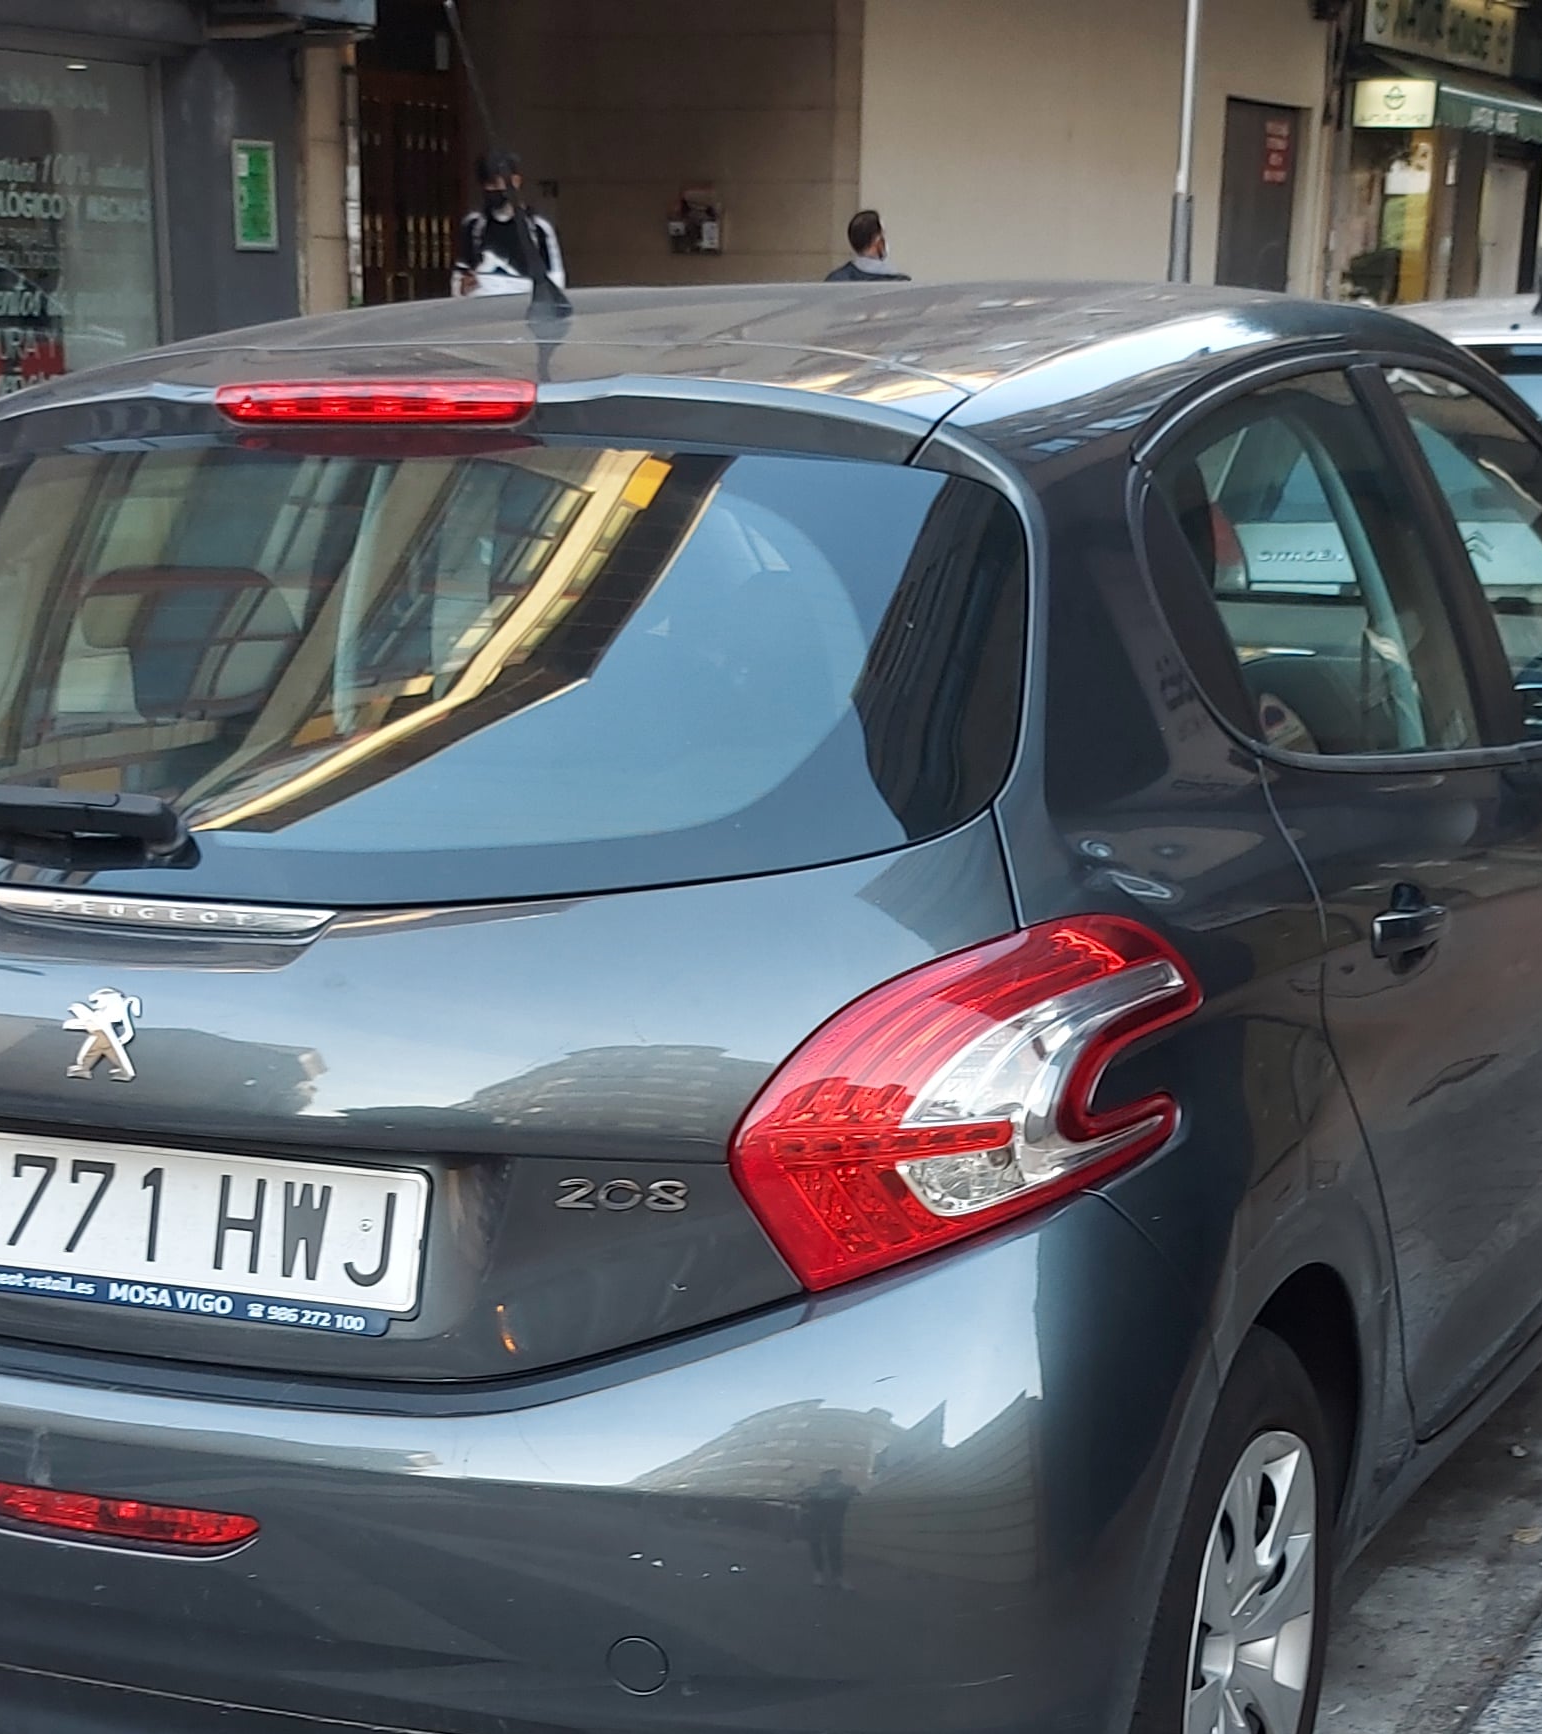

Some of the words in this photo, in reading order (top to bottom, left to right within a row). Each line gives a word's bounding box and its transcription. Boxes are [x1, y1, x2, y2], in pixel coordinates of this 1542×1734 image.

[53, 899, 255, 926] PEUGEOT
[554, 1177, 689, 1213] 208
[213, 1174, 397, 1287] HWJ
[109, 1282, 172, 1308] MOSA
[175, 1290, 234, 1315] VIGO
[267, 1305, 299, 1323] 986
[300, 1309, 332, 1328] 272
[335, 1313, 366, 1332] 100
